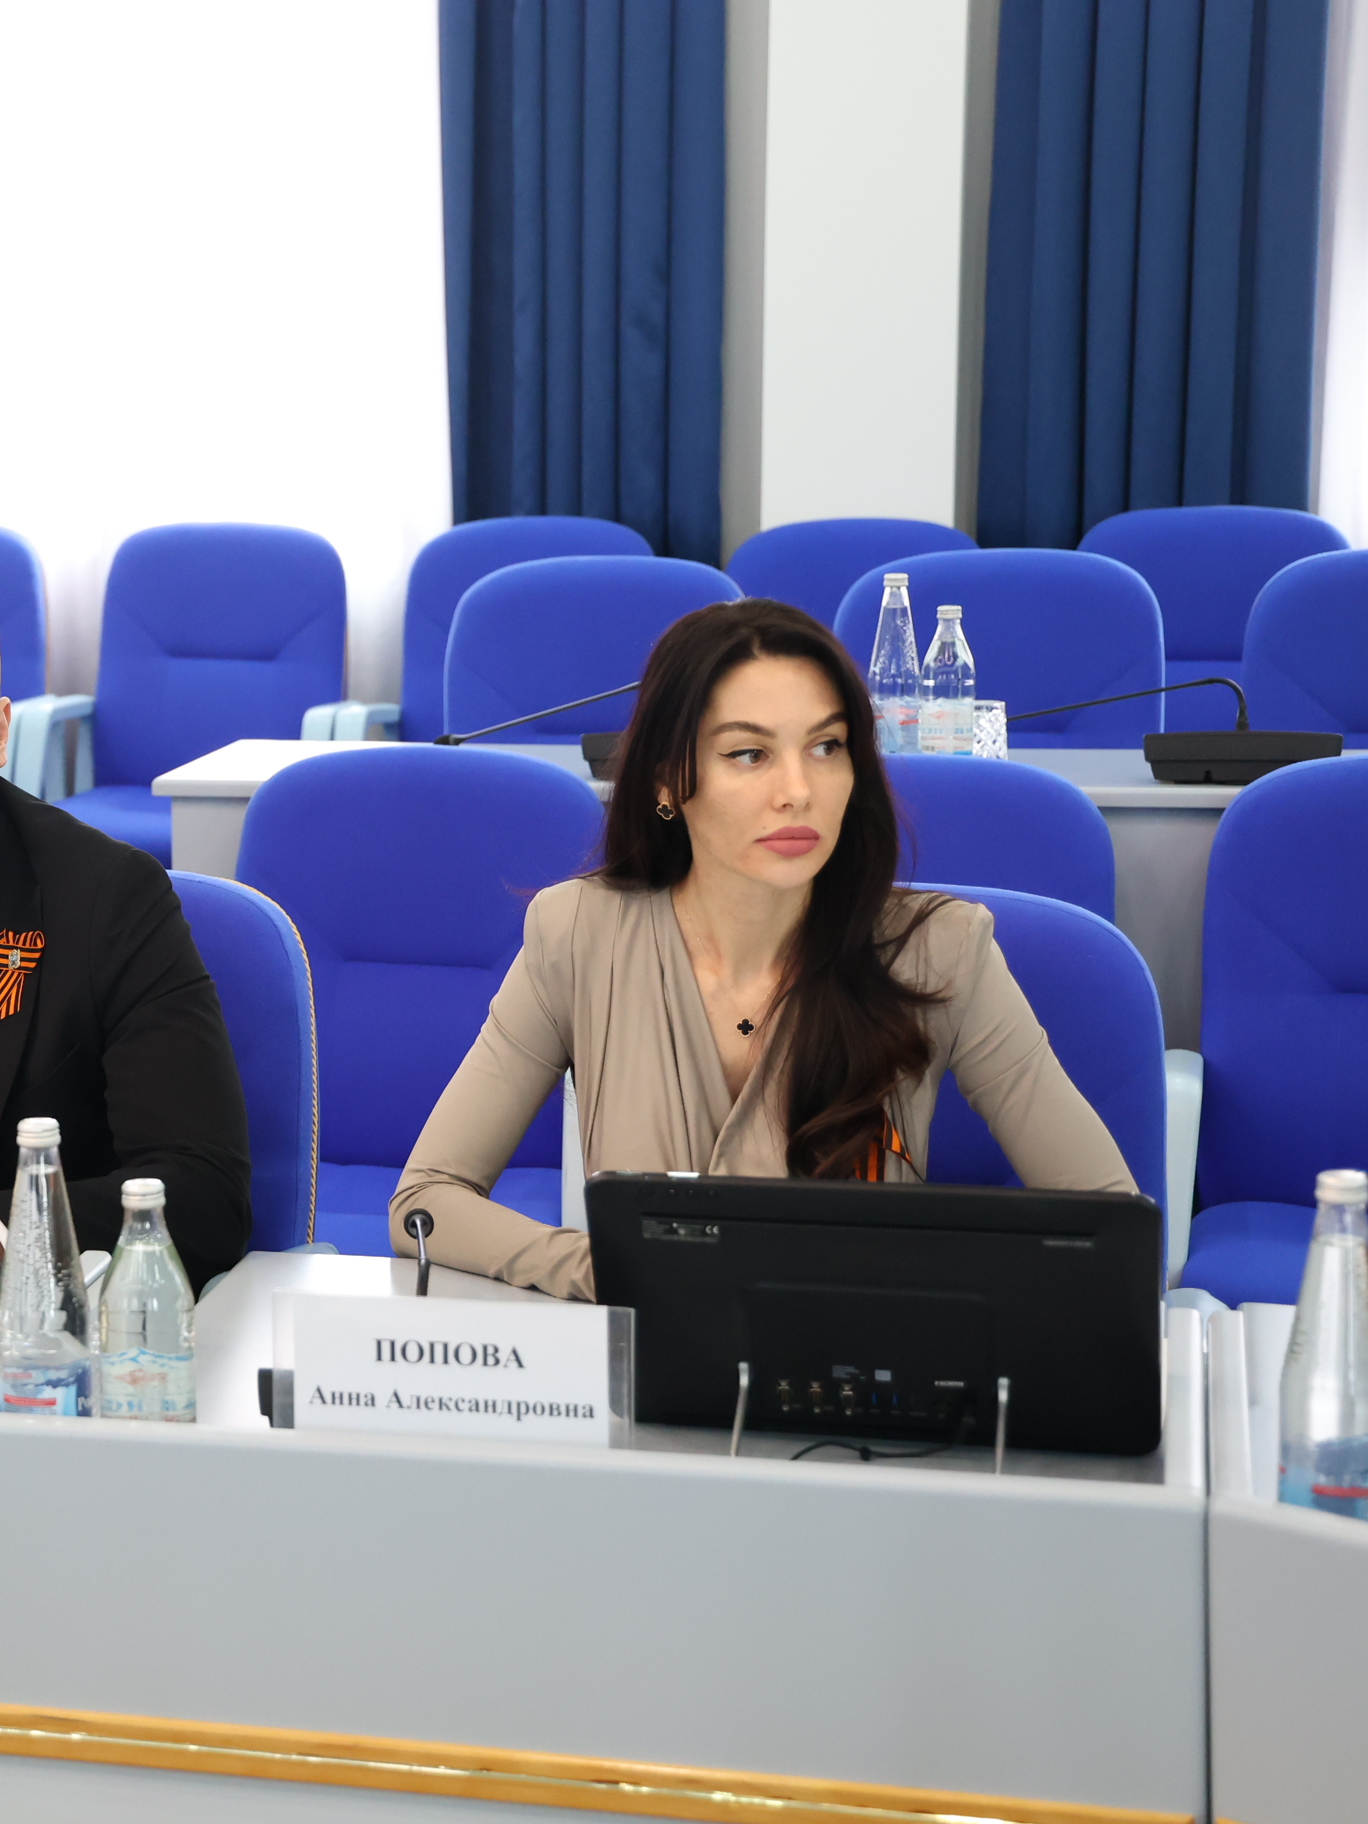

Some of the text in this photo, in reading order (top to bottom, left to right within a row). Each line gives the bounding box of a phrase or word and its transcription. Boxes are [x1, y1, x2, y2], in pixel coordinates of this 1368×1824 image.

[374, 1338, 525, 1369] ПОПОВА
[308, 1384, 596, 1422] Анна Александровна
